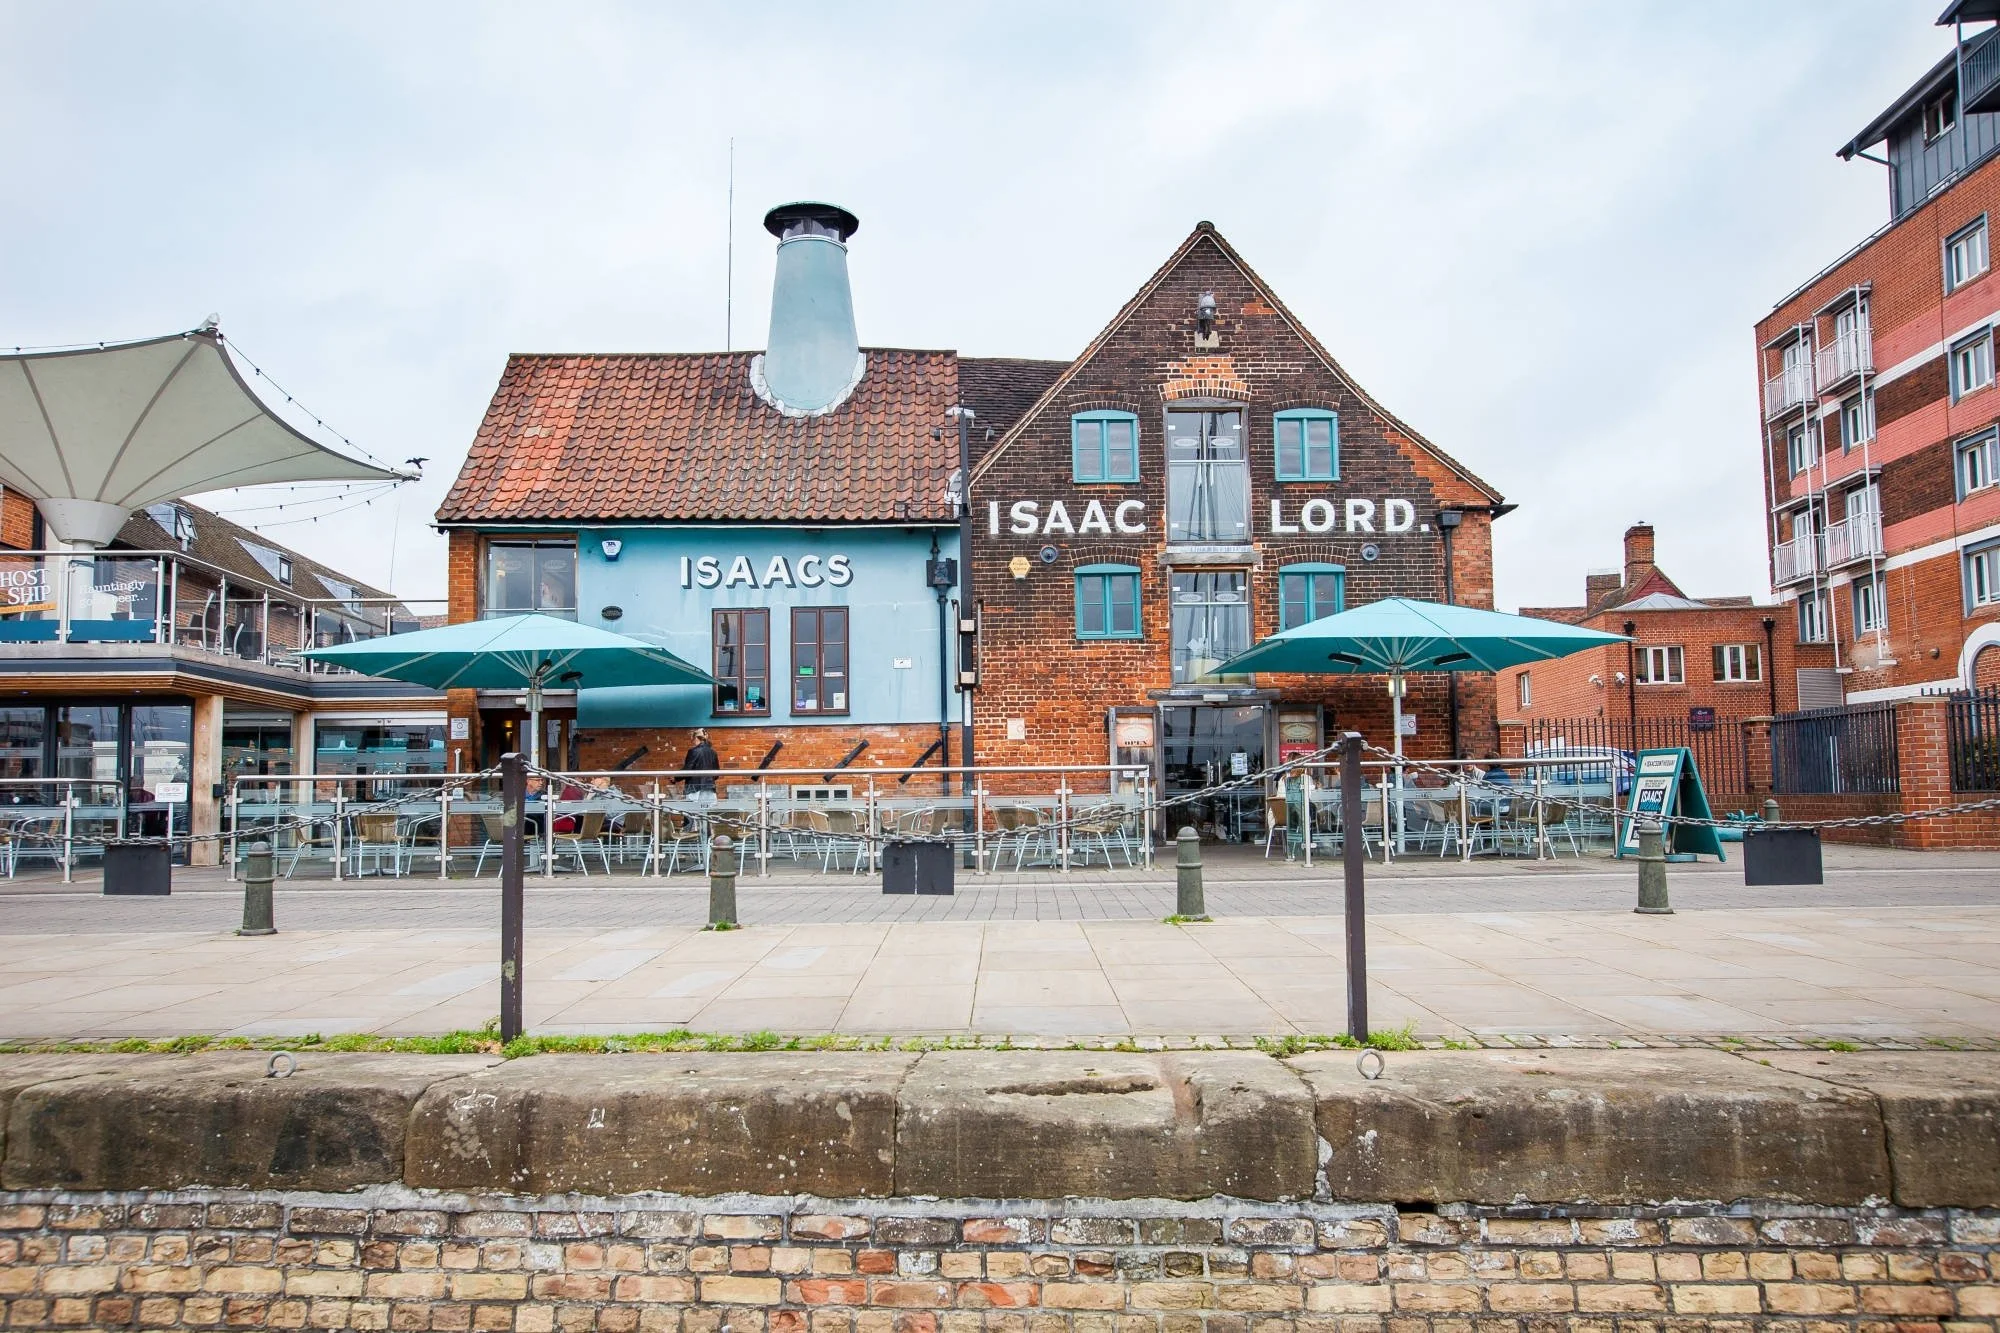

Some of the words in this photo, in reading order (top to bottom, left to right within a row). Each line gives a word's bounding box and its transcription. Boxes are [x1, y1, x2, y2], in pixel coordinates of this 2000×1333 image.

[989, 500, 1147, 535] ISAAC
[1271, 499, 1430, 533] LORD.
[680, 554, 853, 589] ISAACS
[7, 585, 51, 605] SHIP
[110, 591, 148, 603] eer...
[1640, 790, 1663, 803] ISAACS
